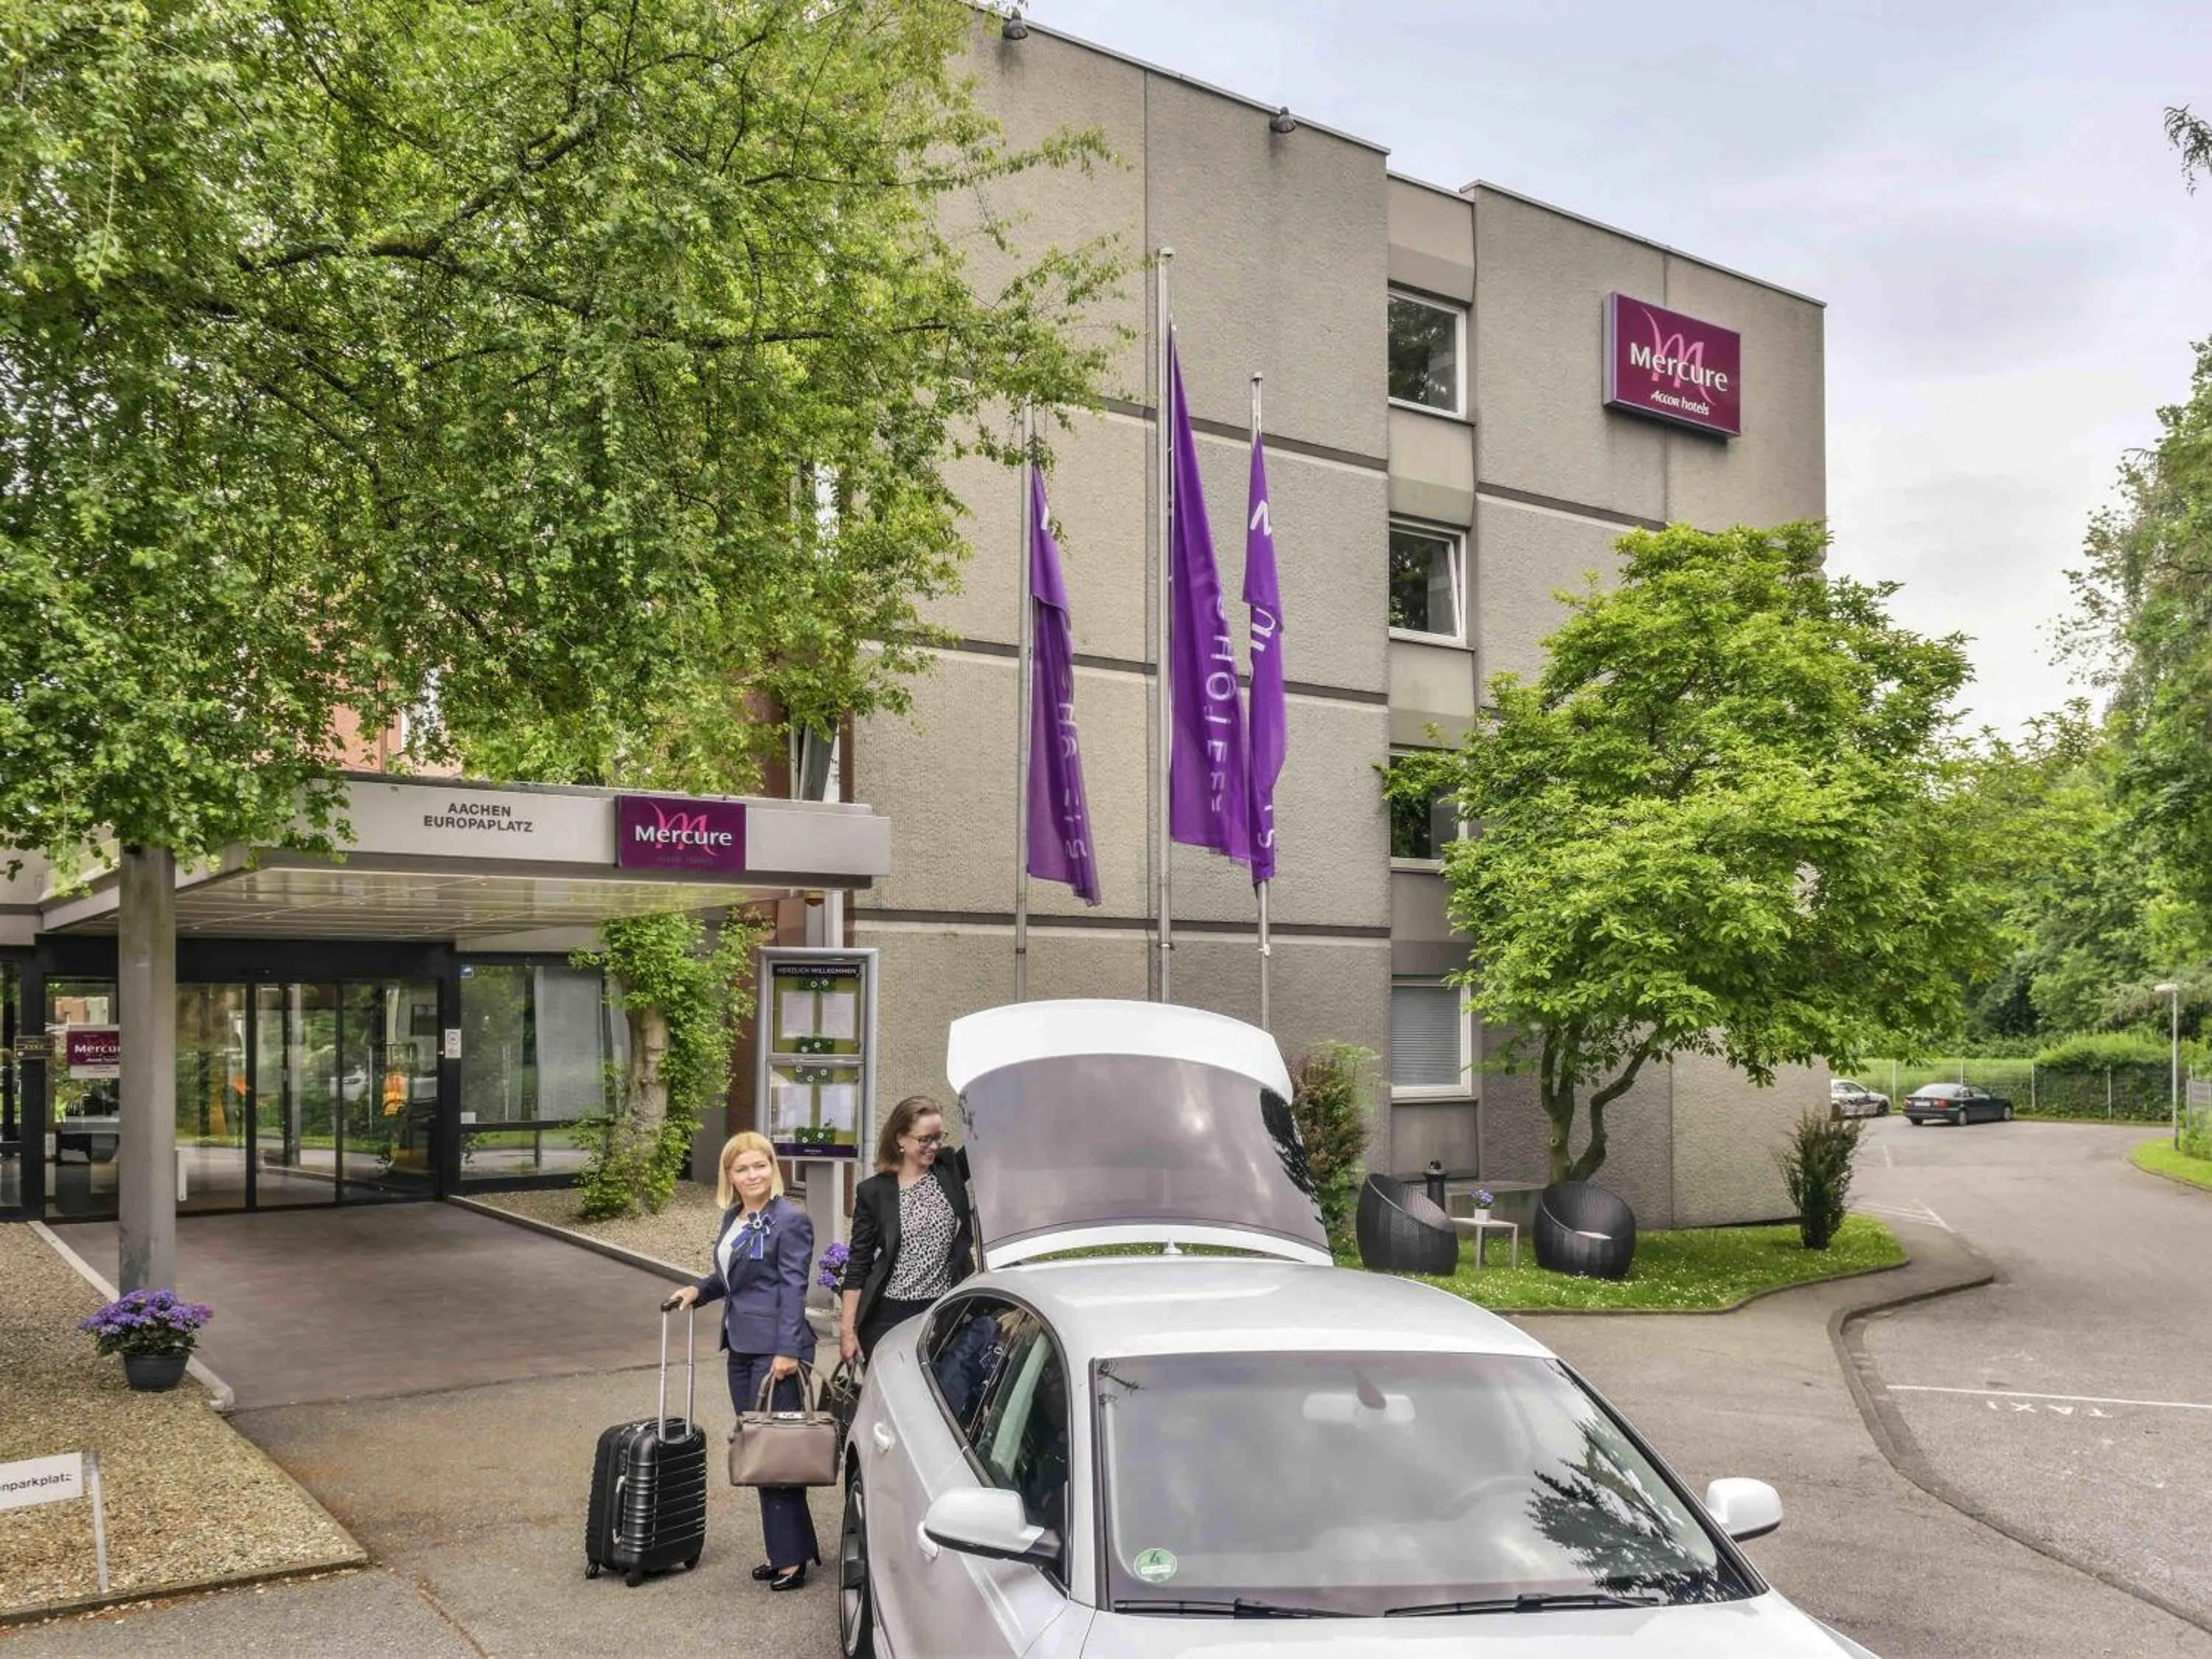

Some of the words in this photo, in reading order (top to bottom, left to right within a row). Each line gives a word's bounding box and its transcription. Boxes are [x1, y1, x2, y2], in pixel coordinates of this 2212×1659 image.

[1630, 341, 1728, 392] Mercure
[448, 802, 512, 817] AACHEN
[423, 815, 533, 832] EUROPAPLATZ
[634, 824, 732, 846] Mercure
[74, 1043, 120, 1054] Mercu
[0, 1472, 72, 1492] nparkplatz
